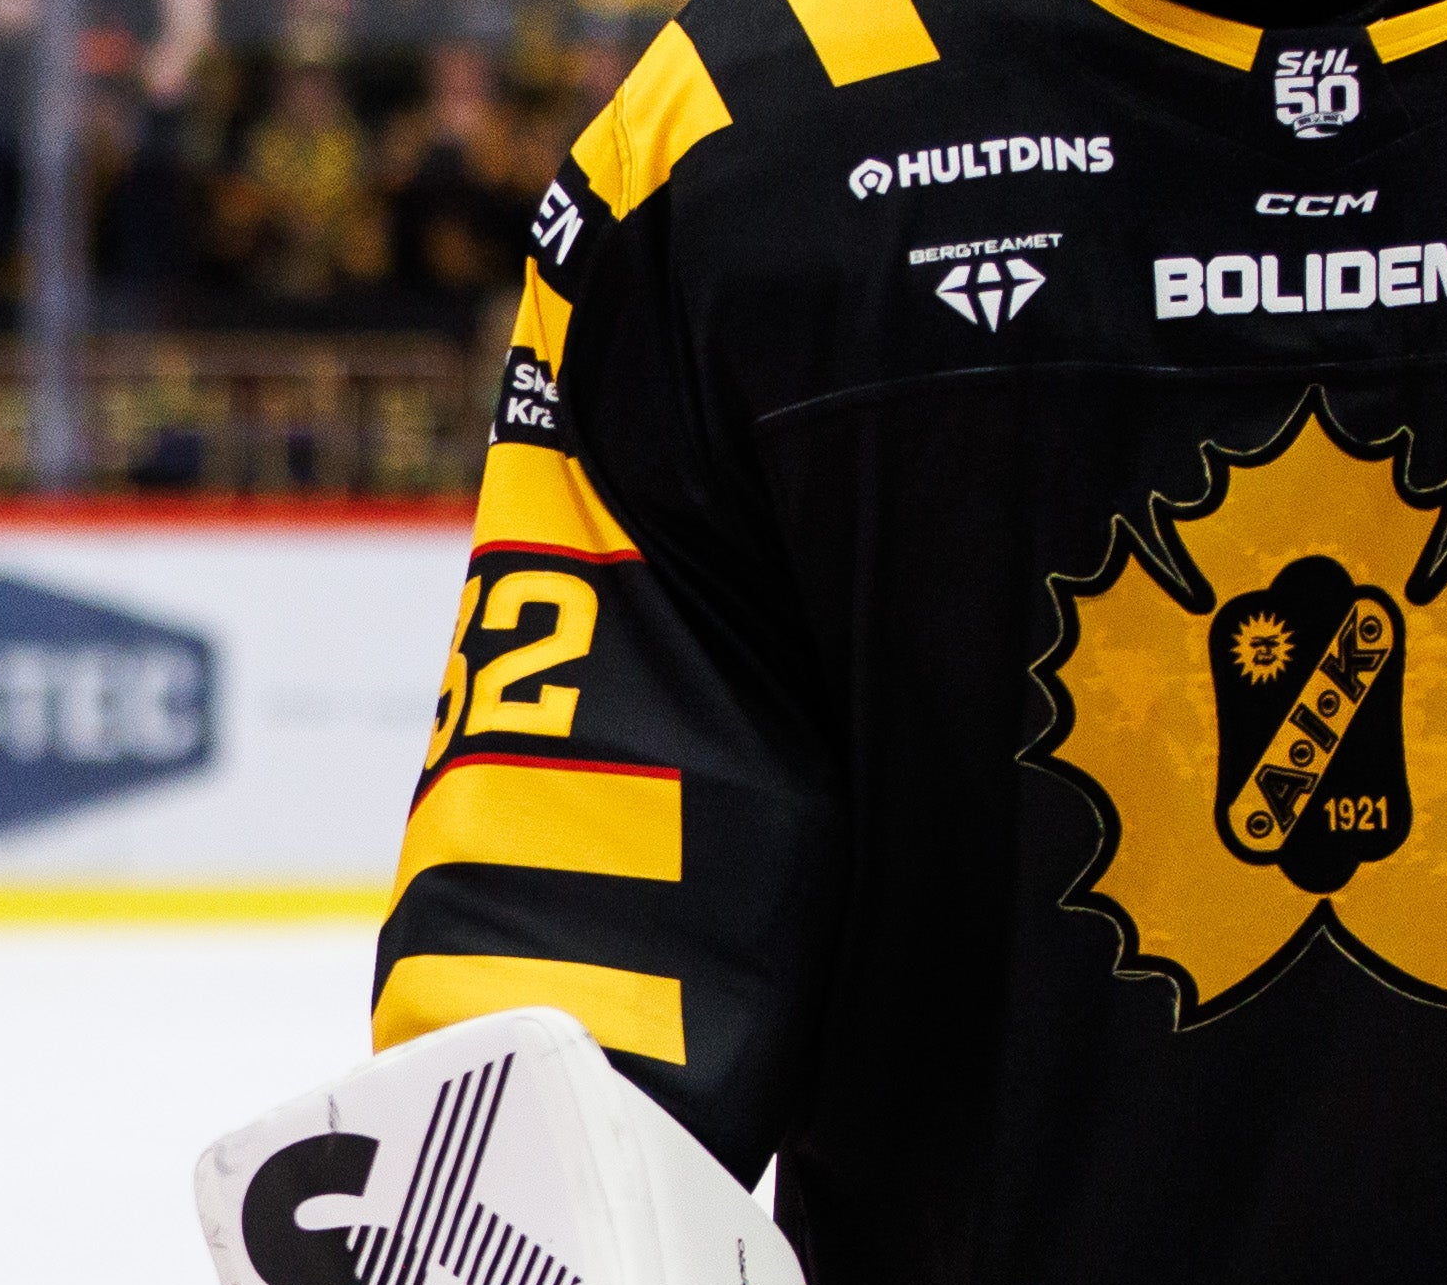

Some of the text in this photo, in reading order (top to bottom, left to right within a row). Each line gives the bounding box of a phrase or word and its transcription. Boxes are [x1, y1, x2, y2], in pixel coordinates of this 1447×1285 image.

[1275, 47, 1359, 78] SHL
[1274, 74, 1360, 125] 50
[897, 135, 1115, 189] HULTDINS
[1254, 189, 1379, 217] CCM
[908, 232, 1064, 265] BERGTEAMET
[1323, 796, 1389, 831] 1921
